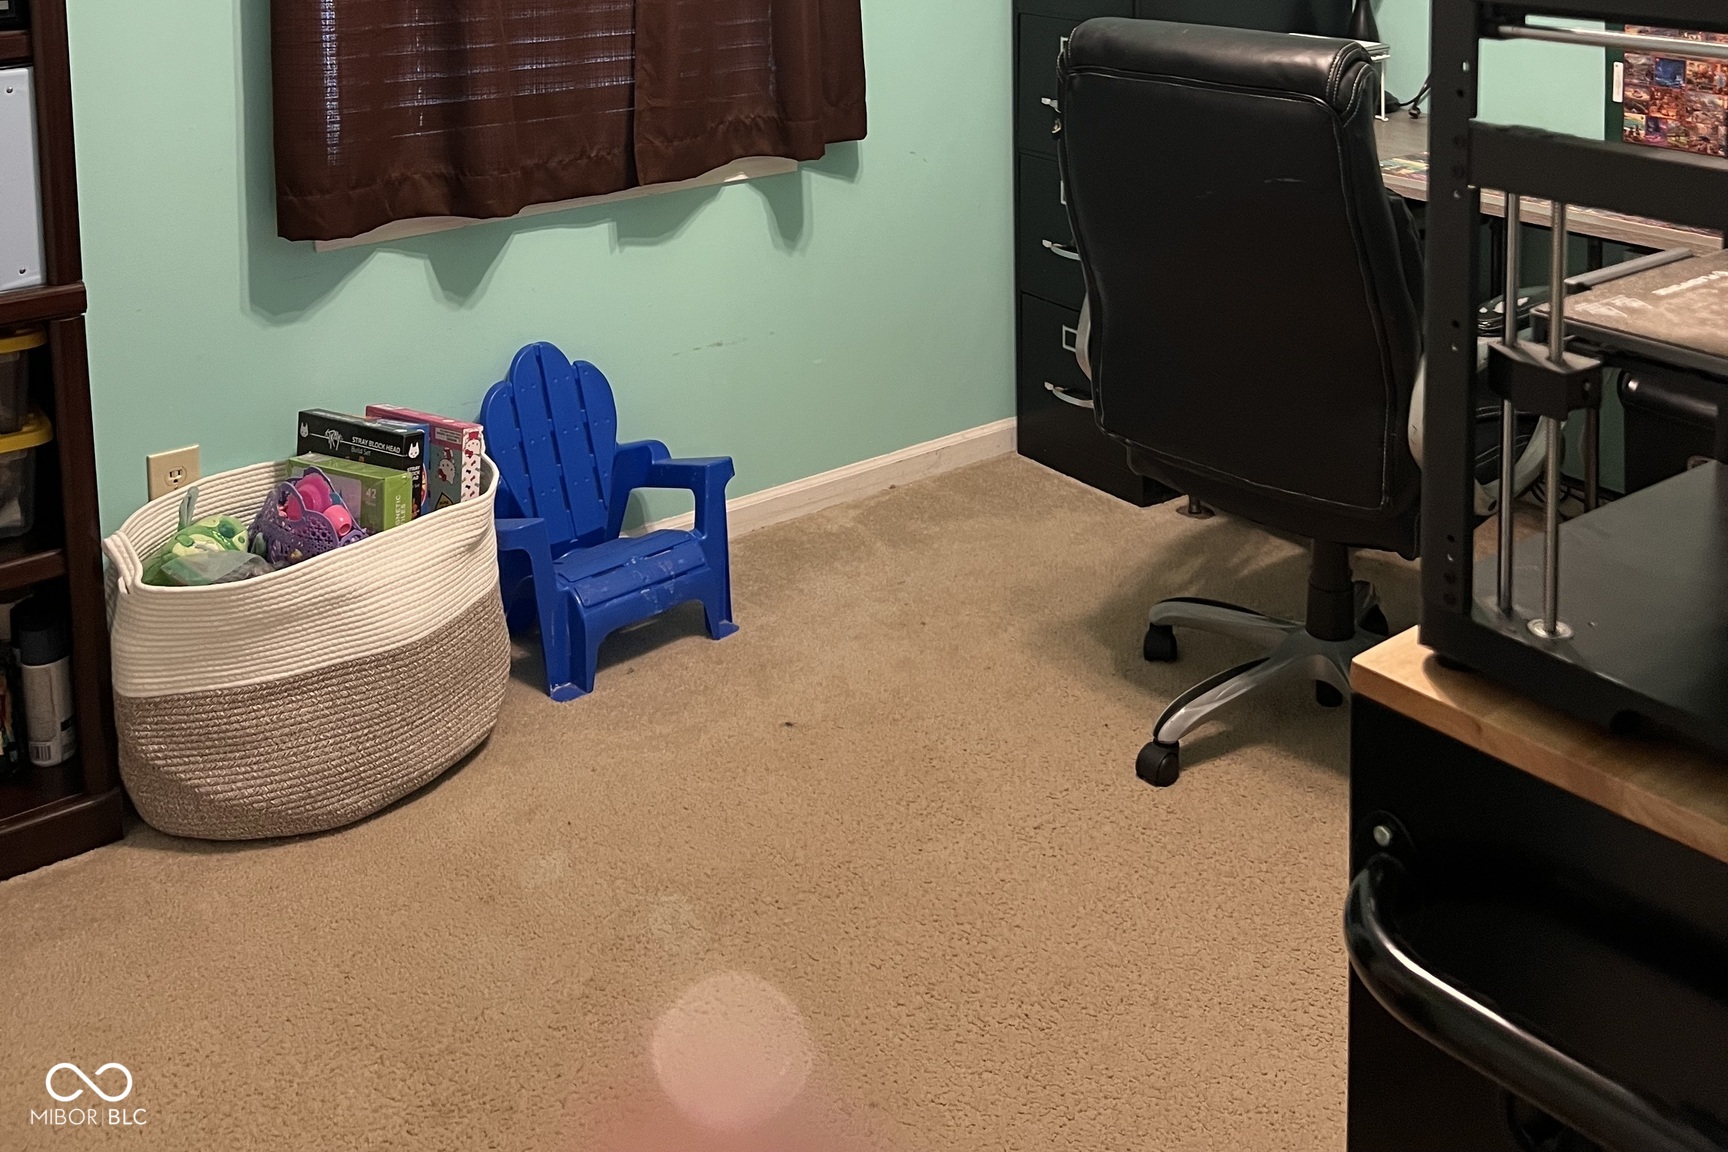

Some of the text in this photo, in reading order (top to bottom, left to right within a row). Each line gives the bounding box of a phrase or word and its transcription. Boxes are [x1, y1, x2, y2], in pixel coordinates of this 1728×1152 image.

[352, 436, 368, 446] STRAY
[368, 440, 385, 450] BLOCK
[386, 444, 401, 454] HEAD
[366, 488, 377, 499] 42
